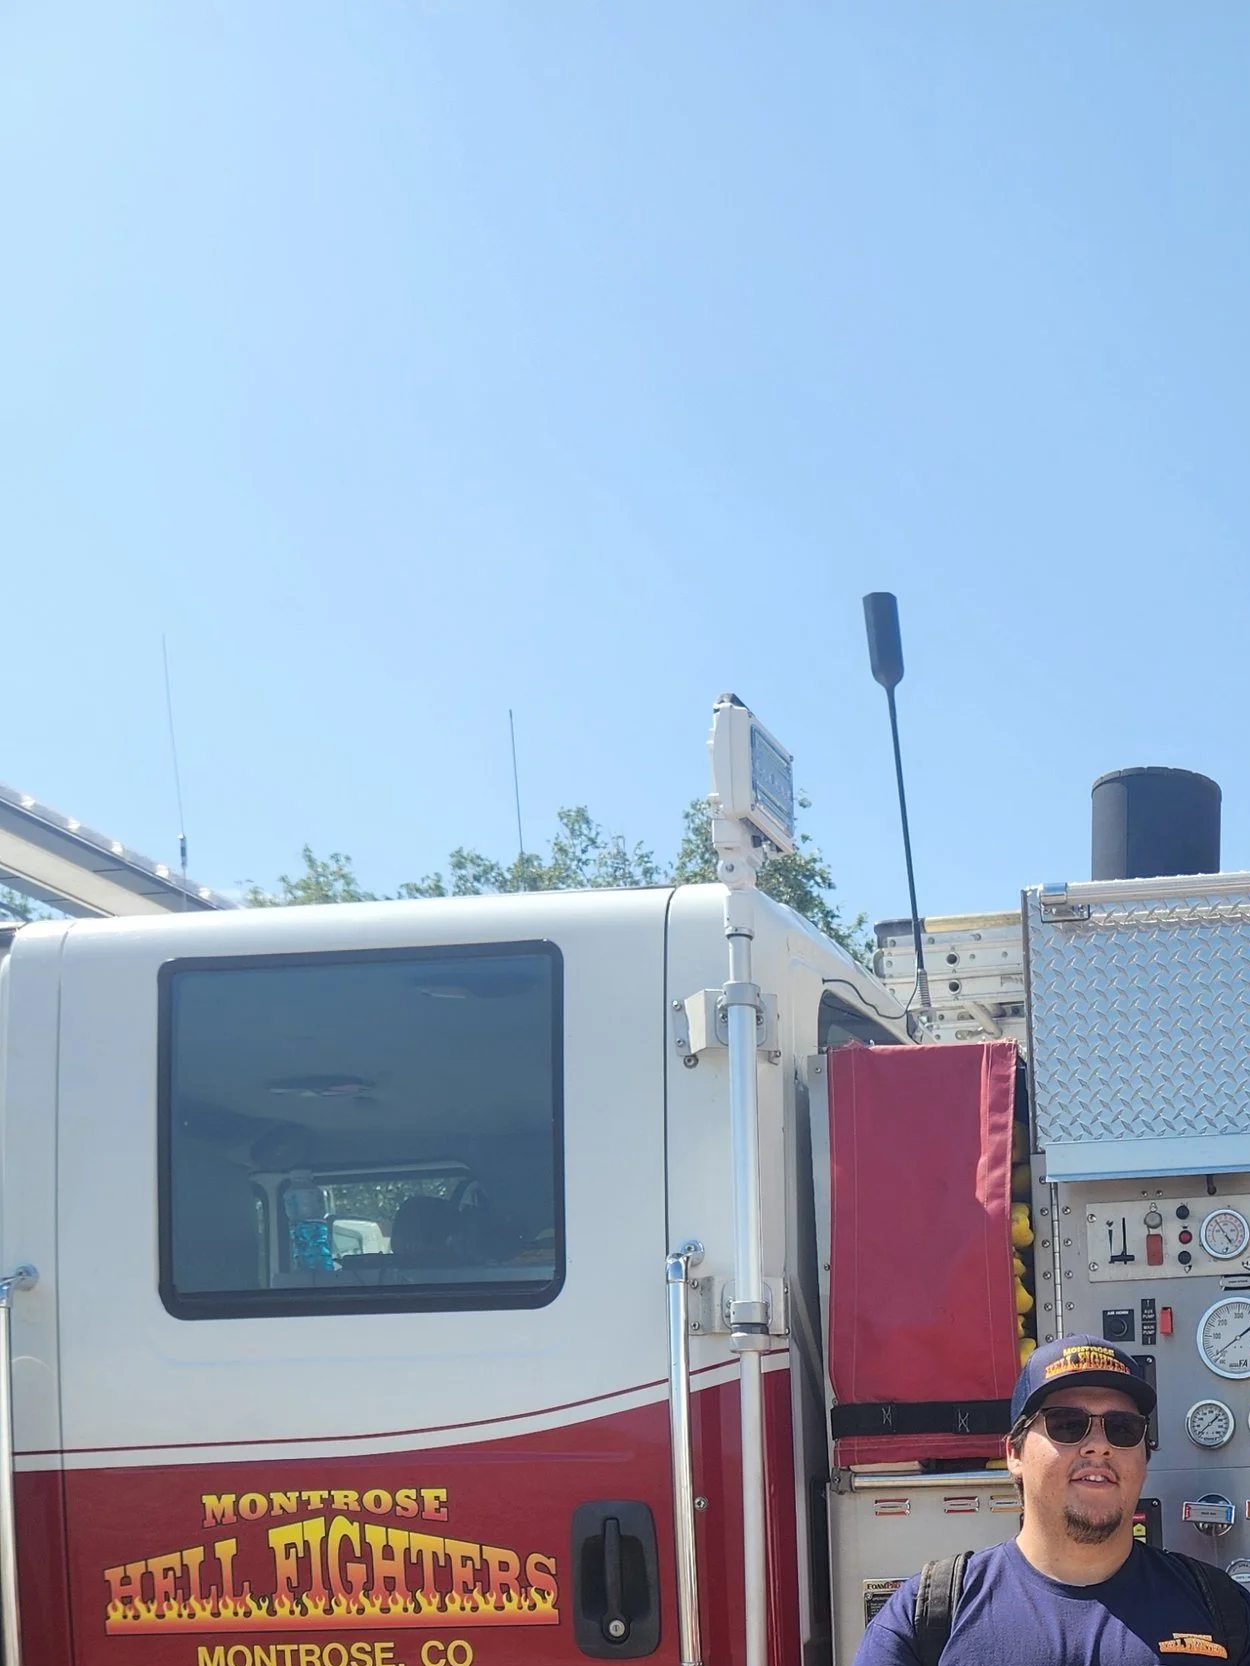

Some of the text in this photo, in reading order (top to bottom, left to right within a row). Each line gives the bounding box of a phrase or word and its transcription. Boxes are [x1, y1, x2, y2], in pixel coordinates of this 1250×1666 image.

[1063, 1346, 1116, 1357] MONTROSE
[1078, 1350, 1131, 1374] FIGHTERS
[201, 1487, 448, 1529] MONTROSE
[103, 1514, 559, 1618] HELL FIGHTERS
